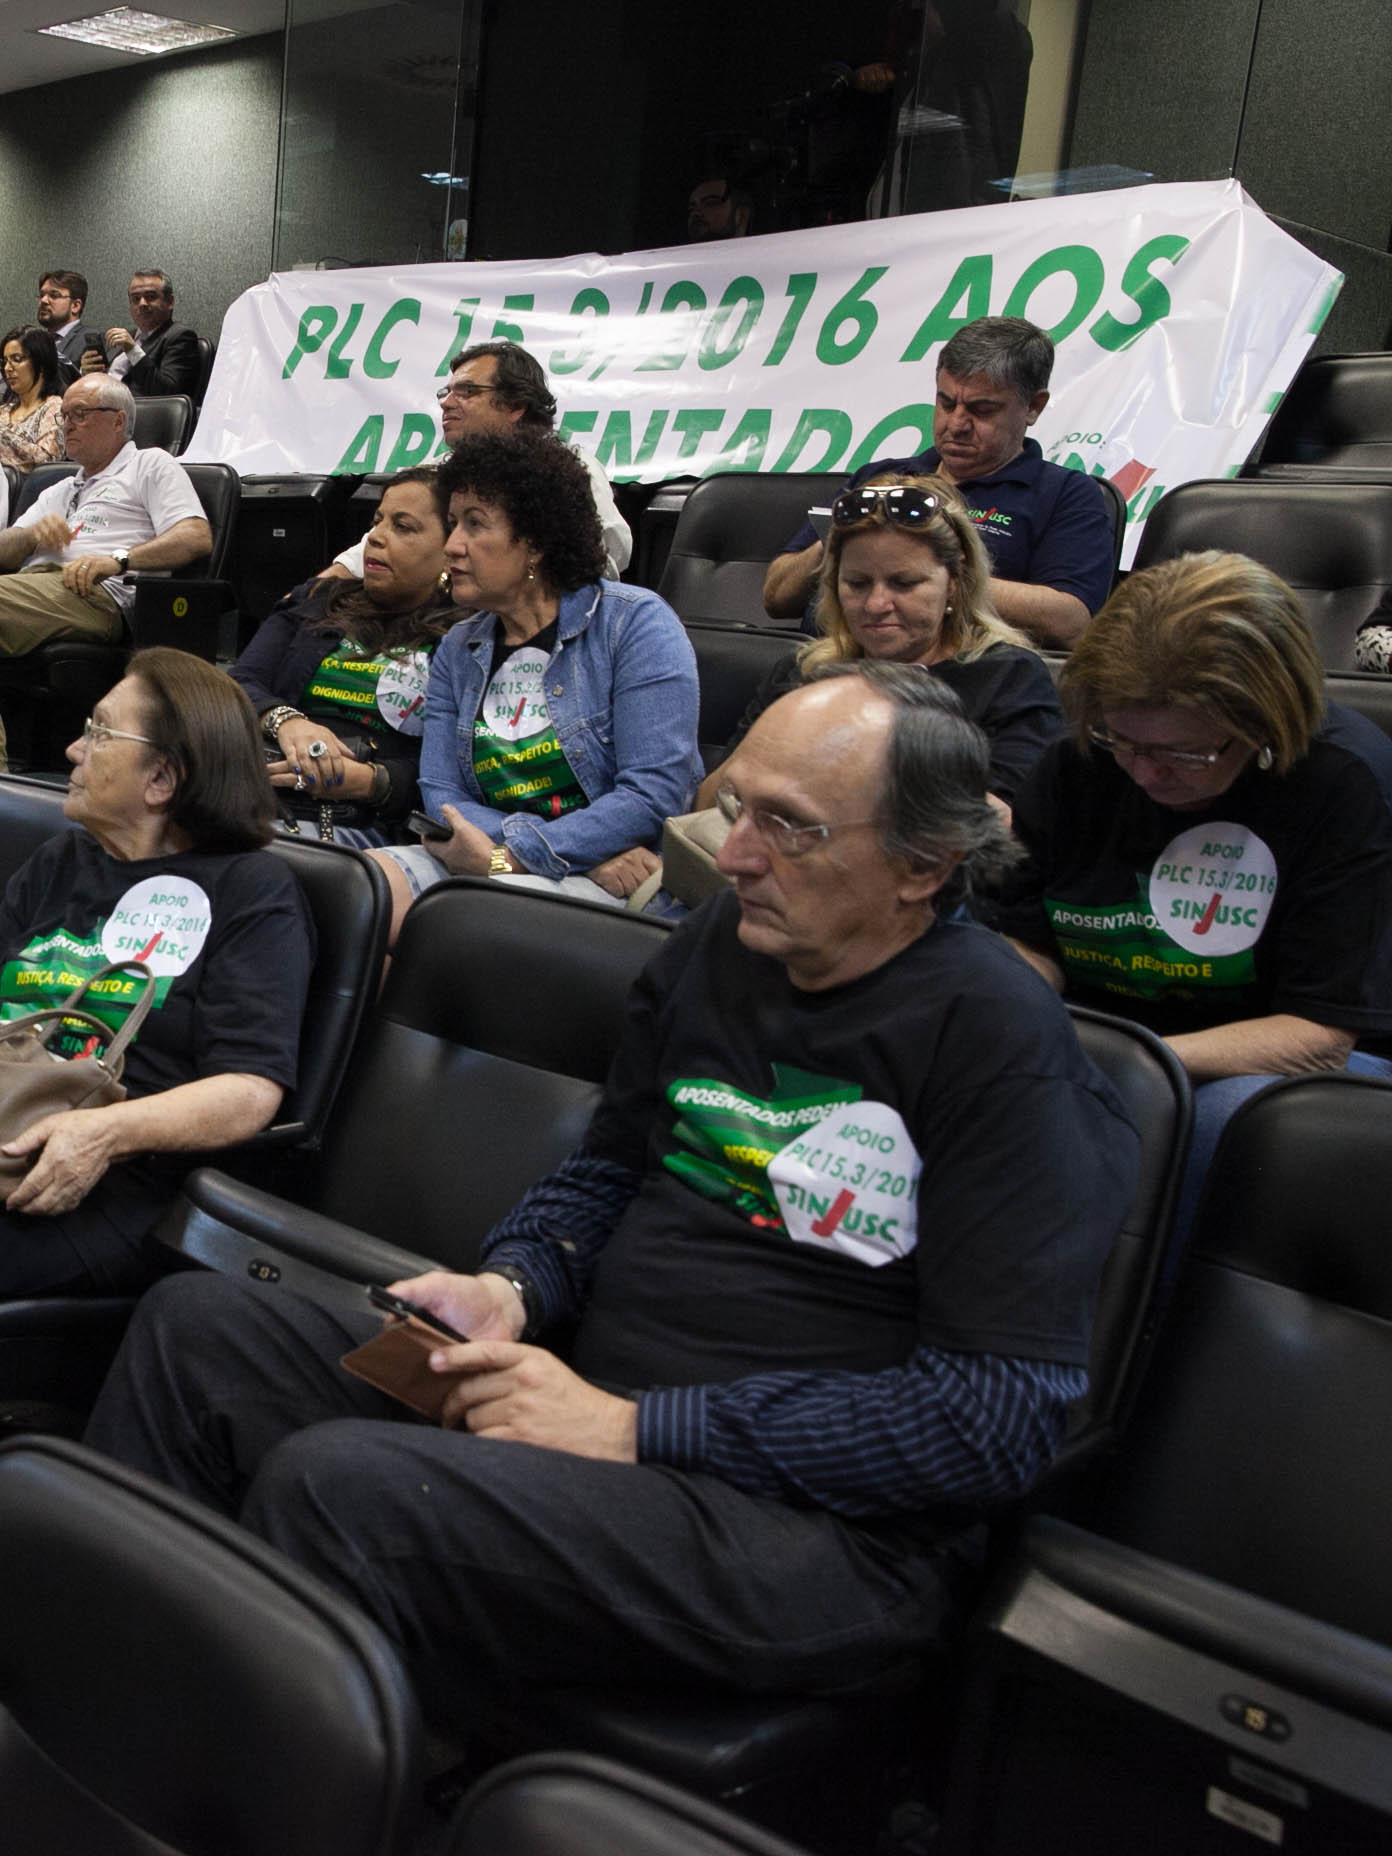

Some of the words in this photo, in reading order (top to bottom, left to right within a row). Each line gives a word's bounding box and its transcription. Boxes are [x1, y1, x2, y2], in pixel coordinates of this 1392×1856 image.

[282, 298, 421, 380] PLC
[435, 265, 890, 382] 153/2016
[899, 234, 1192, 363] AOS
[342, 661, 386, 675] RESPEIT
[385, 668, 407, 684] PLC
[511, 663, 543, 674] APOIO
[312, 685, 376, 705] DIGNIDADE!
[489, 682, 506, 696] PLC
[385, 692, 427, 720] SINJU
[1200, 843, 1244, 860] APOIO
[1157, 863, 1192, 885] PLC
[1198, 867, 1276, 896] 15.3/2016
[148, 893, 189, 909] APOIO
[113, 911, 142, 926] PLC
[143, 912, 208, 933] 153/2016
[1131, 954, 1198, 978] RESPEITO
[1202, 963, 1213, 978] E
[56, 971, 122, 994] RESEITO
[122, 981, 136, 995] E
[674, 1086, 794, 1128] APOSENTADOS
[839, 1123, 896, 1155] APOIO
[786, 1142, 822, 1171] PLC
[822, 1152, 917, 1203] 15.3/201
